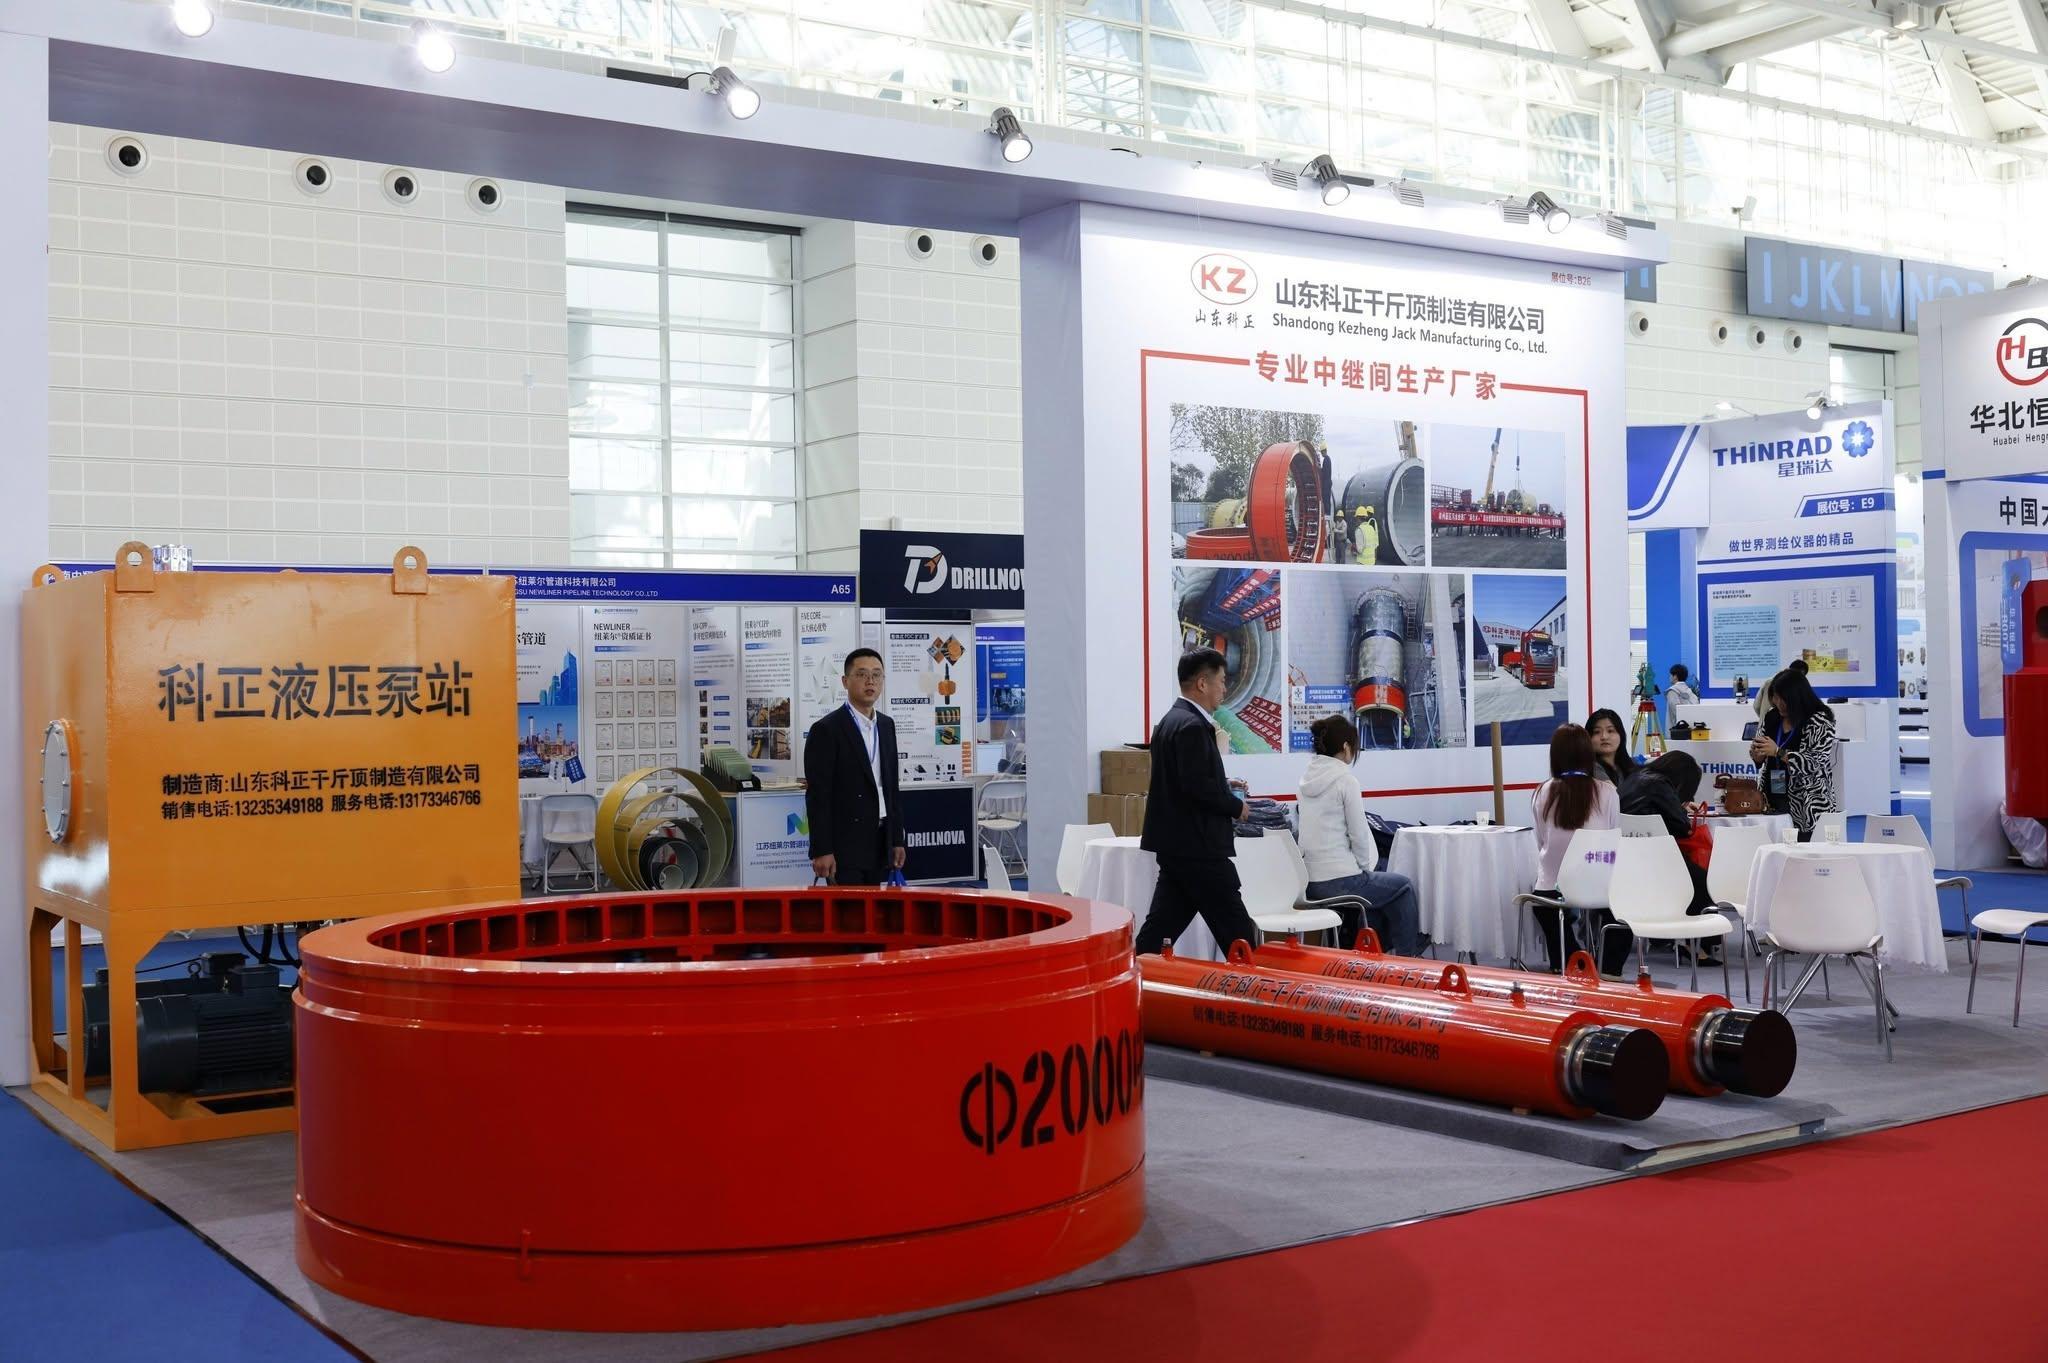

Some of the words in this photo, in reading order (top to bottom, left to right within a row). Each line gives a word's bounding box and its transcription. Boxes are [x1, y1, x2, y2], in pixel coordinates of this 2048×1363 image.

[1201, 264, 1247, 295] KZ
[1196, 309, 1255, 330] 山东科正
[1272, 313, 1334, 335] Shandong
[1338, 321, 1388, 341] Kezheng
[1392, 326, 1416, 341] Jack
[1420, 329, 1501, 352] Manufacturing
[1505, 338, 1524, 353] Co.,
[1528, 340, 1547, 354] Ltd.
[1255, 350, 1497, 400] 专业中继间生产厂家
[1993, 433, 2020, 446] Huabei
[1778, 458, 1833, 478] 星瑞达
[1861, 497, 1875, 509] E9
[1729, 532, 1854, 552] 做世界测绘仪器的精品
[831, 584, 851, 594] A65
[593, 623, 631, 631] NEWLINER
[158, 661, 473, 722] 科正液压泵站
[161, 797, 324, 820] 销售电话:13235349188
[331, 790, 481, 812] 服务电话:13173346766
[907, 830, 966, 848] DRILLNOVA
